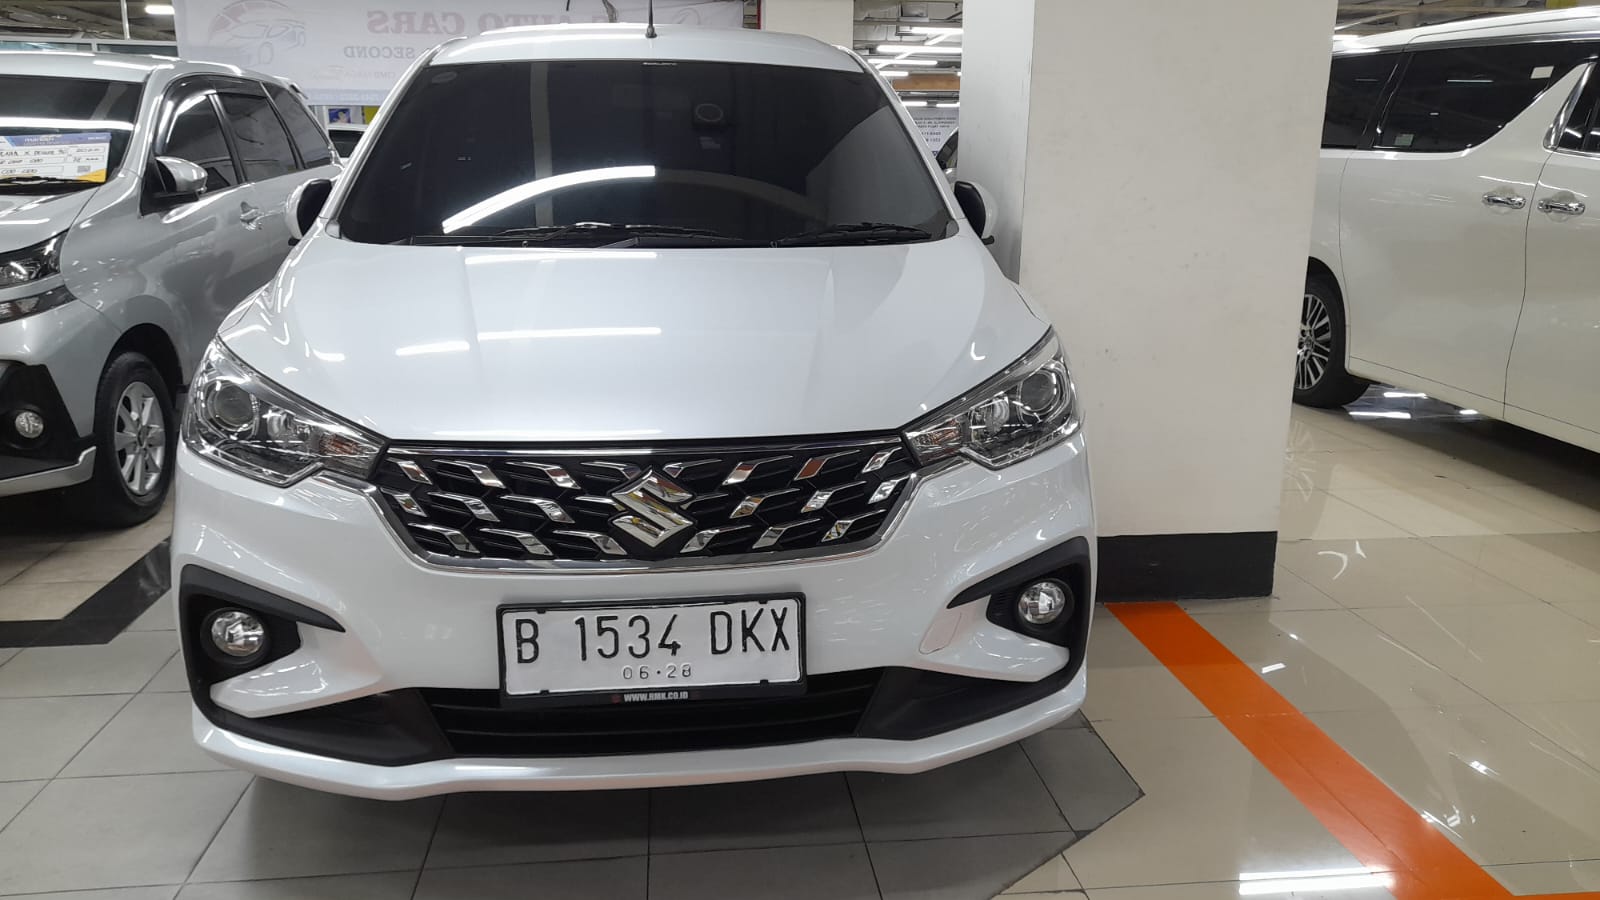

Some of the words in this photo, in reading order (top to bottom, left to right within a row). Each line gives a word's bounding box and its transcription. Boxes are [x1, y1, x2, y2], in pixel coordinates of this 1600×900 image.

[515, 618, 540, 664] B
[574, 614, 682, 662] 1534
[709, 607, 790, 655] DKX
